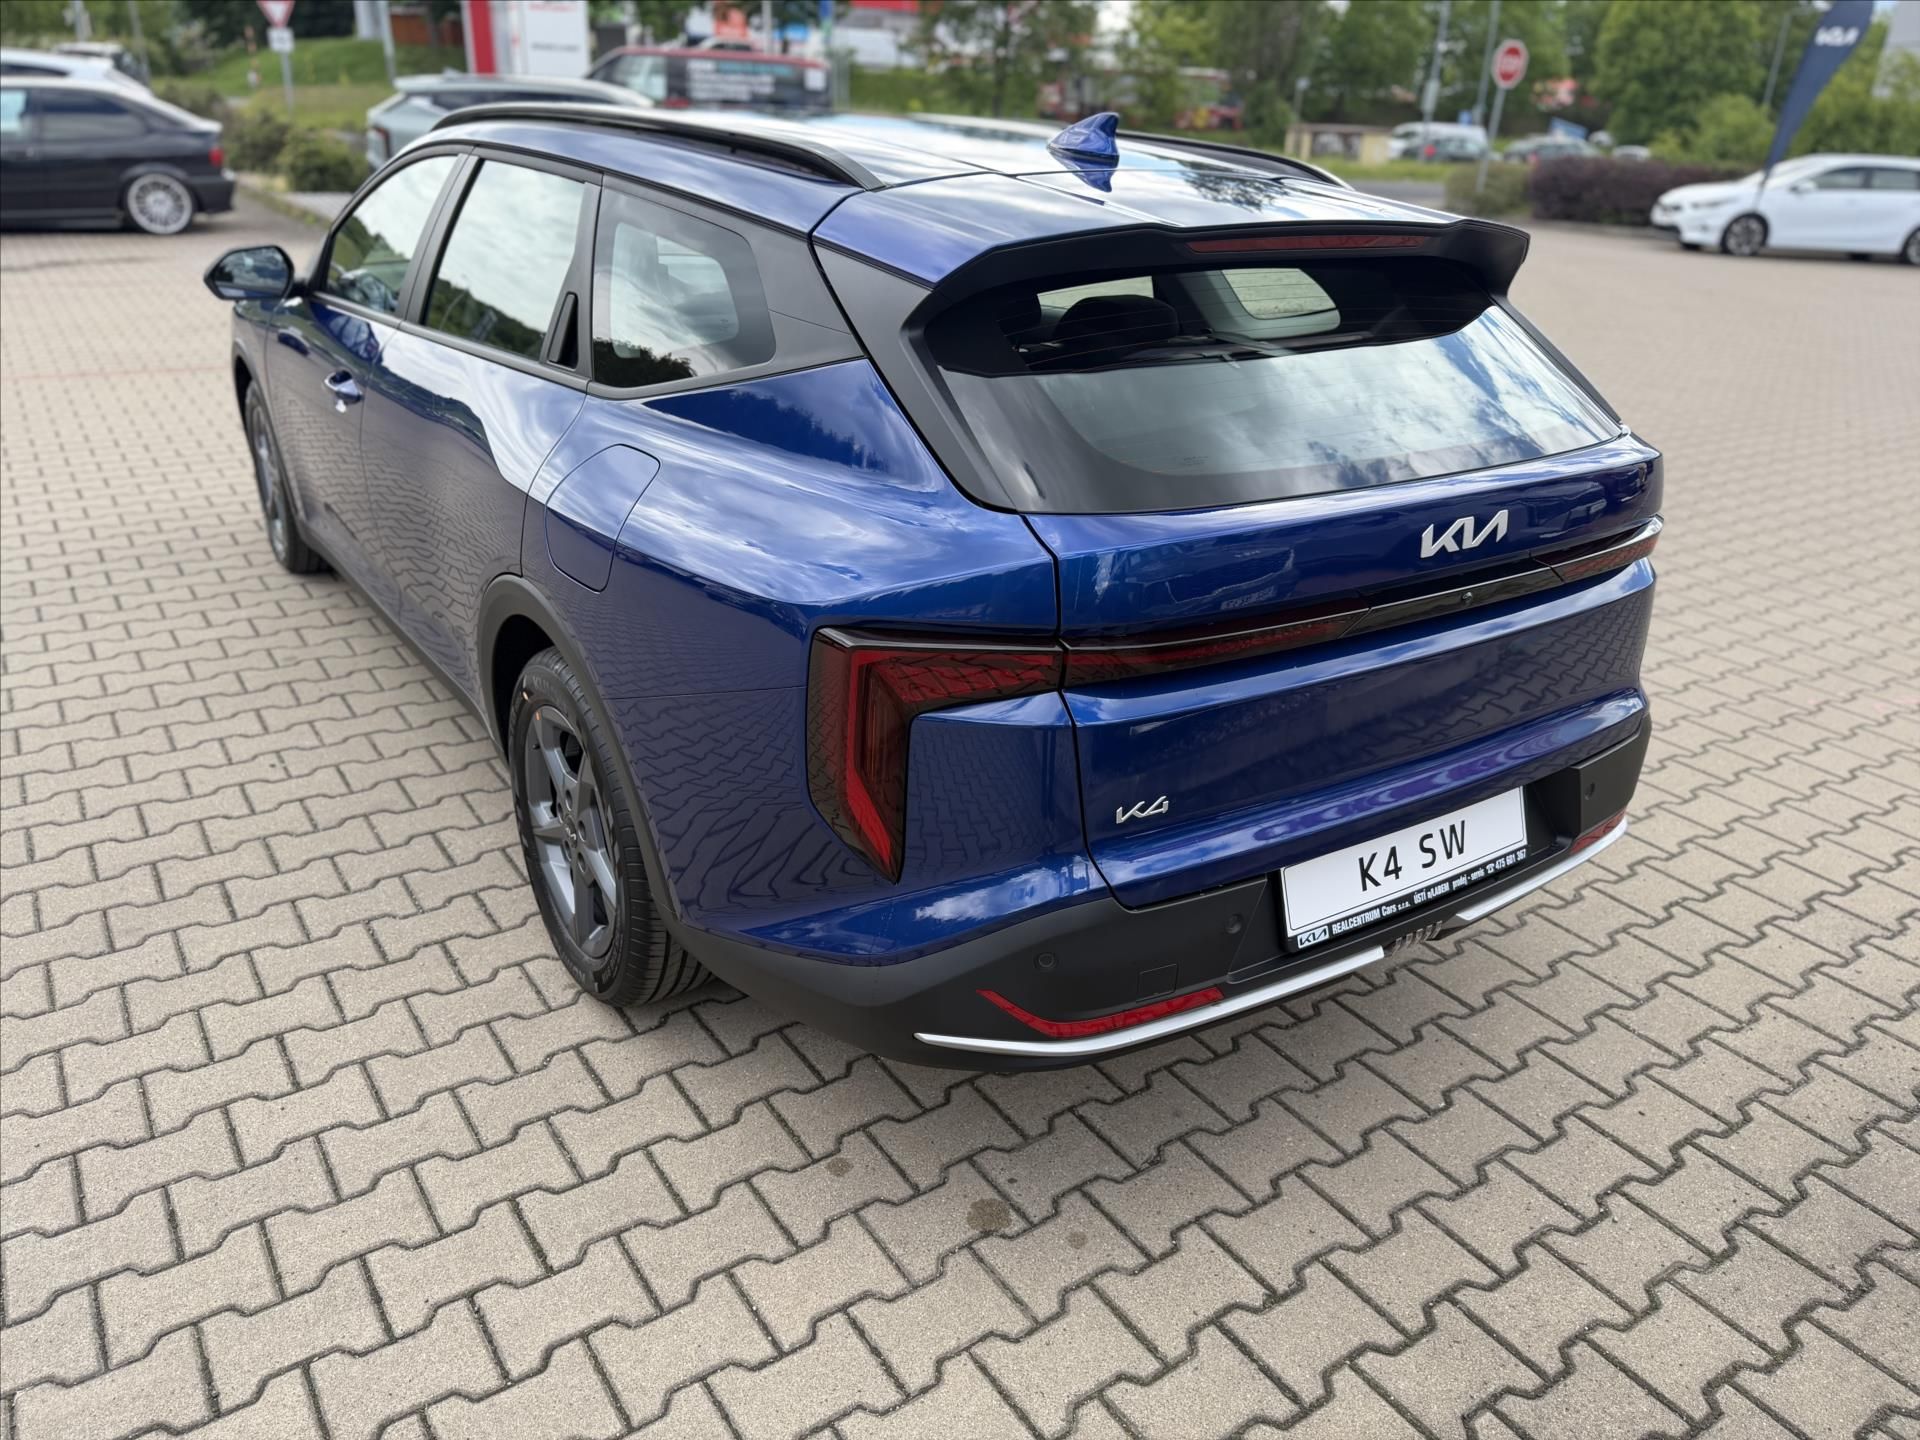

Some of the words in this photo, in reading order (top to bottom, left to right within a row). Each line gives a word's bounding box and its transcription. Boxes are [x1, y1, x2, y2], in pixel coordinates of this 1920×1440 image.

[1420, 509, 1509, 559] KIA
[1116, 795, 1169, 824] K4
[1358, 845, 1402, 892] K4
[1419, 820, 1465, 869] SW
[1299, 927, 1327, 946] KIA
[1332, 907, 1381, 935] REALCENTRUM
[1381, 903, 1397, 916] Cars
